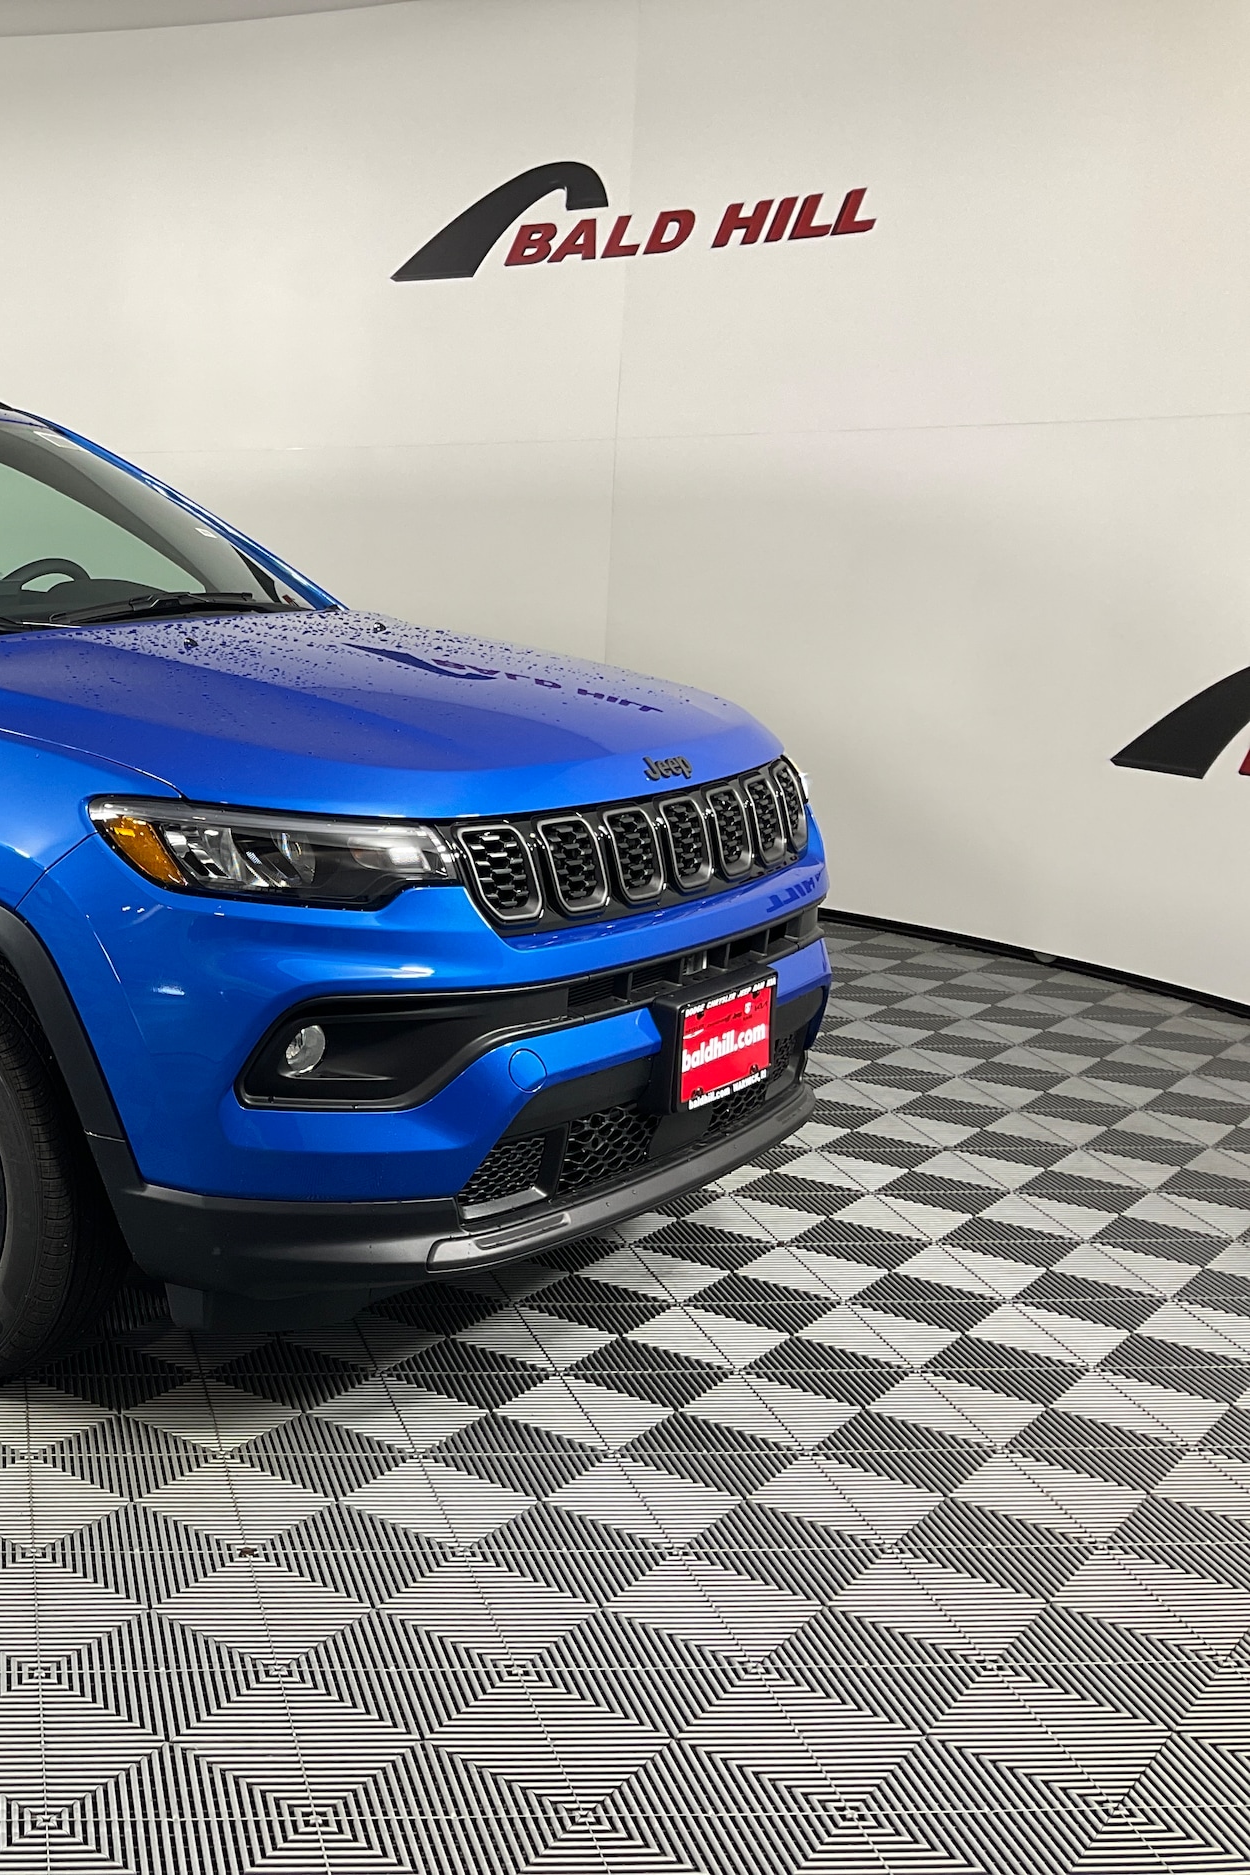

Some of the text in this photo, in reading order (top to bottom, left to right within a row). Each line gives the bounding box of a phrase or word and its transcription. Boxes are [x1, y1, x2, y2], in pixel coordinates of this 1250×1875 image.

[504, 187, 877, 267] BALD HILL
[642, 756, 693, 781] Jeep
[684, 976, 776, 1018] DODGE CHRYSLER JEEP RAM KIA
[682, 1023, 766, 1073] baldhill.com
[688, 1086, 730, 1110] baldhill.com
